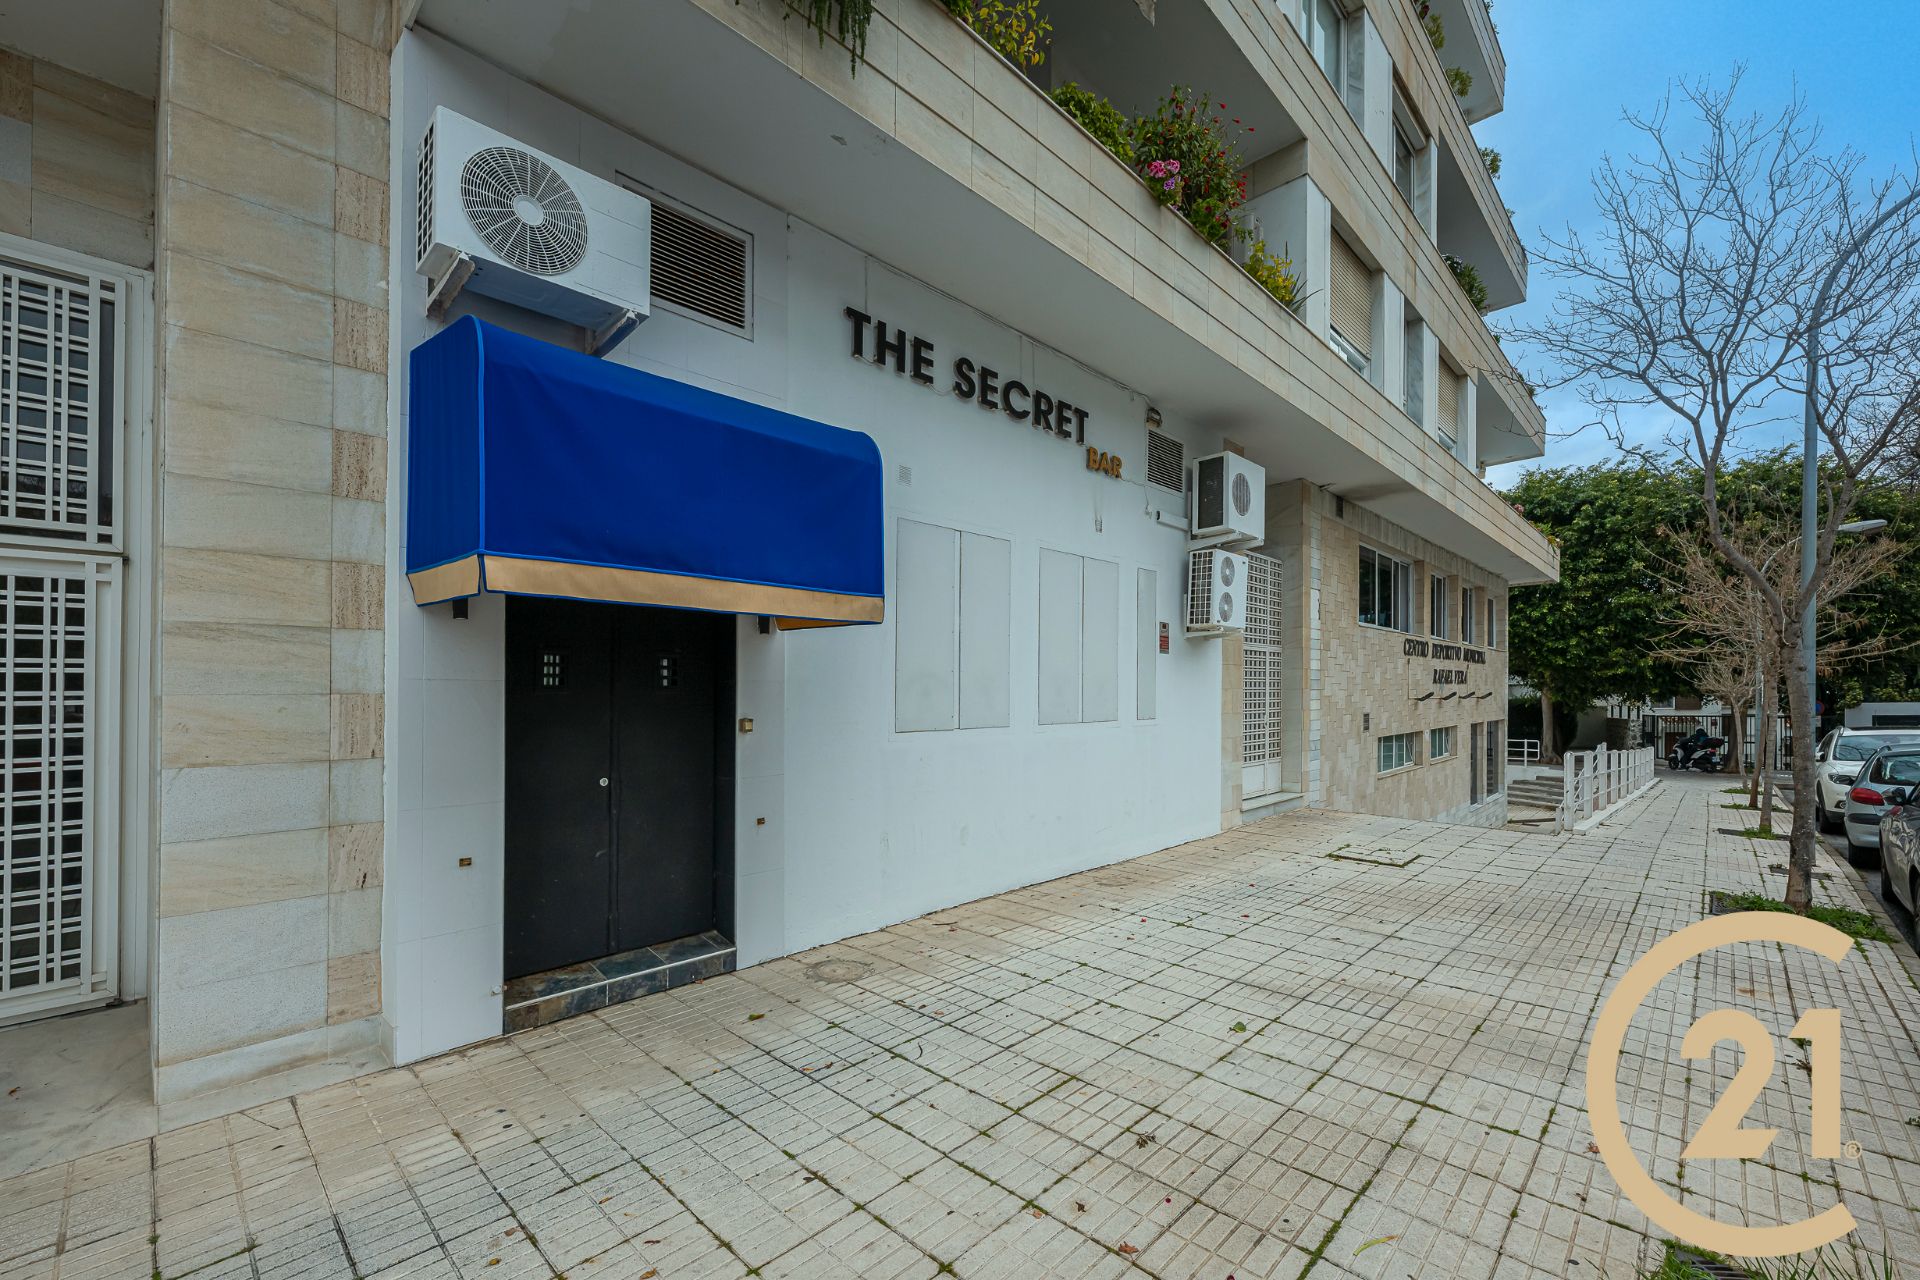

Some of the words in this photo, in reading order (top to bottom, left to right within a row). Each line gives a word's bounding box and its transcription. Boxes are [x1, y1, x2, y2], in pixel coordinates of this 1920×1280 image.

[845, 306, 934, 384] THE
[954, 357, 1089, 444] SECRET
[1087, 446, 1122, 479] BAR
[1404, 638, 1428, 657] CENTRO
[1432, 643, 1461, 661] DEPORTIVO
[1433, 669, 1453, 684] RAFAEL
[1454, 670, 1467, 684] VERA
